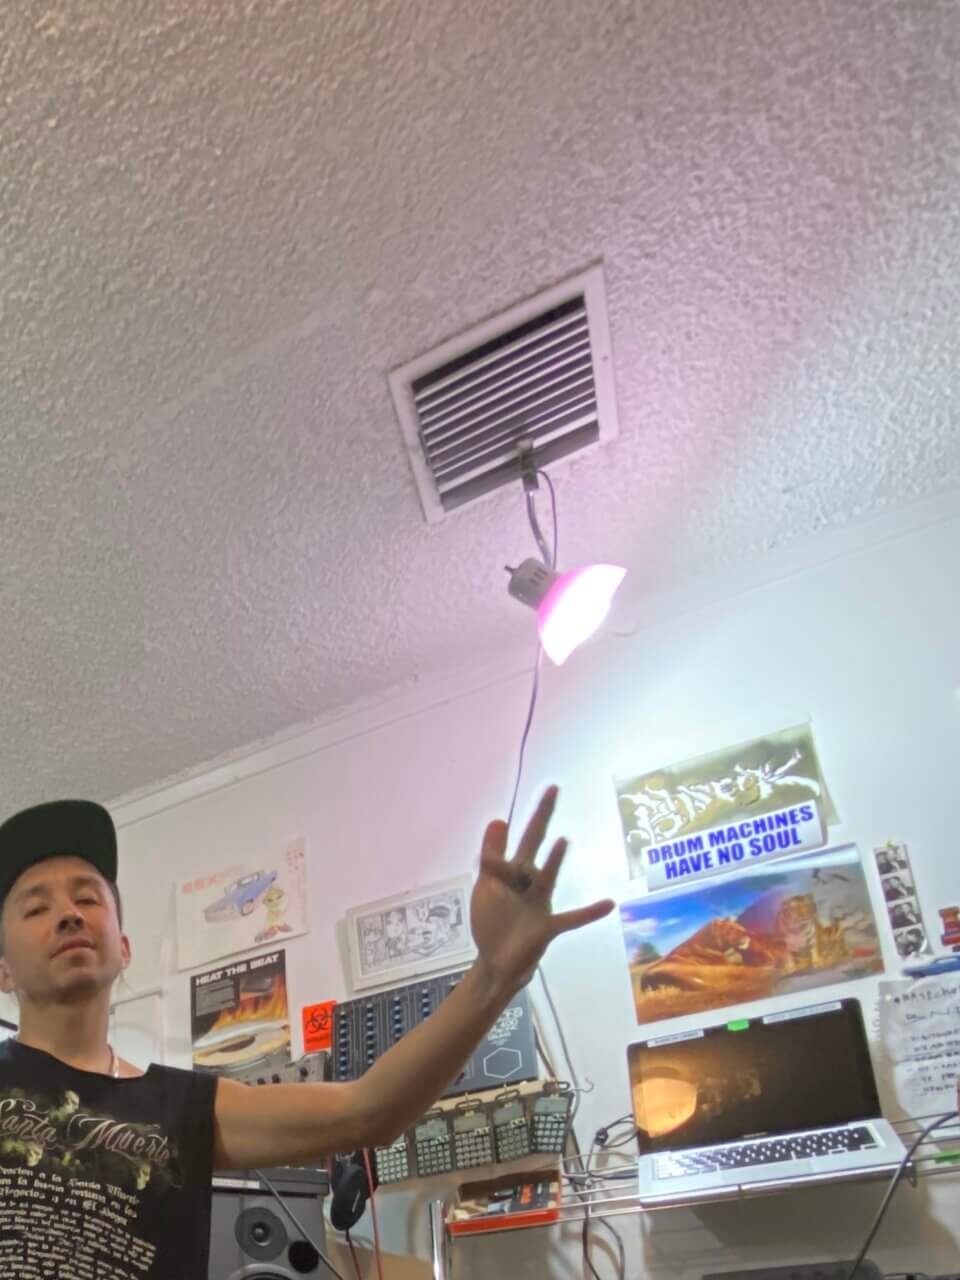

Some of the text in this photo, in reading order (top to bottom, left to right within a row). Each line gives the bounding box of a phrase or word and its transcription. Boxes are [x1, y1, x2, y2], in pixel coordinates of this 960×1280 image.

[647, 805, 814, 865] DRUM MACHINES
[665, 828, 802, 880] HAVE NO SOUL
[195, 970, 223, 986] HEAT
[225, 963, 247, 977] THE
